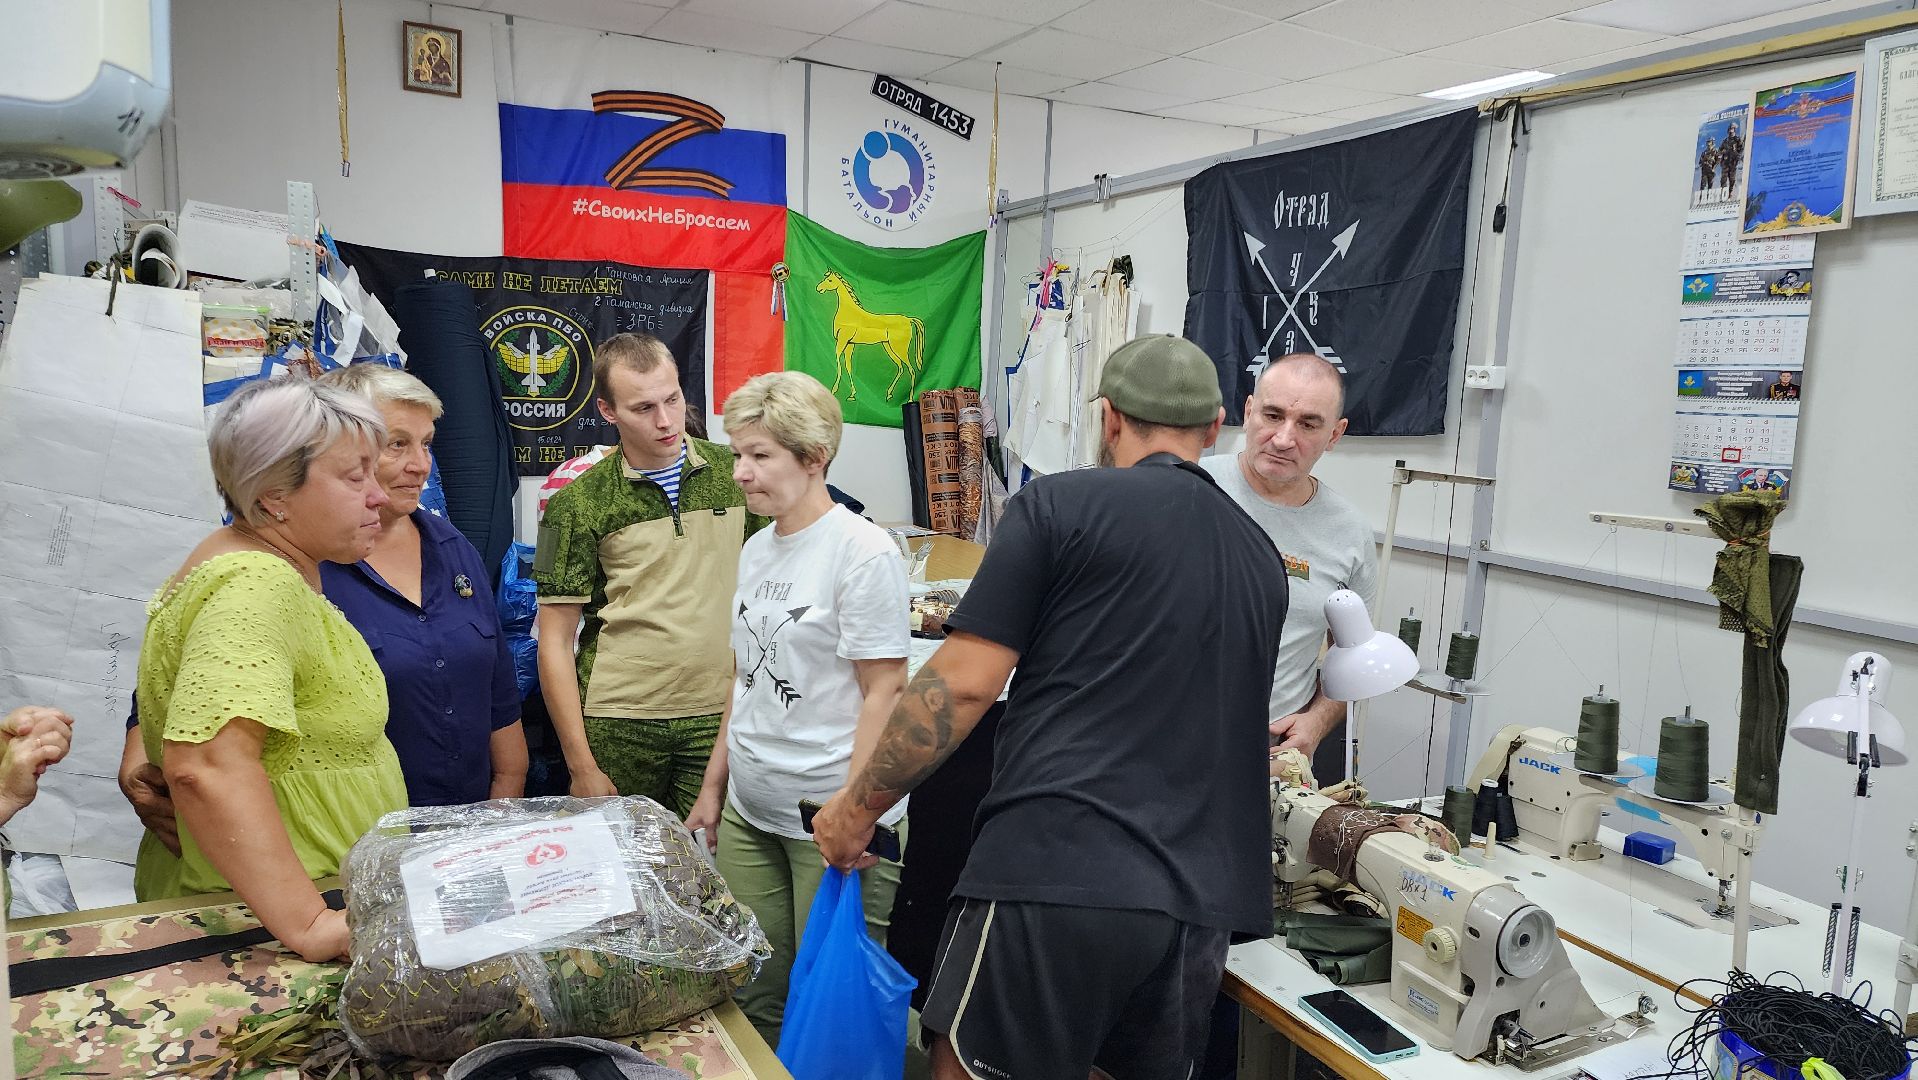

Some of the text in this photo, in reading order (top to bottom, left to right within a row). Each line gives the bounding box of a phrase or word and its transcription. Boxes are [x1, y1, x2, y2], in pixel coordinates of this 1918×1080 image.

[878, 80, 971, 135] ОТРЯД 1453
[884, 119, 936, 223] ГУМАНИТАРНЫЙ
[841, 158, 893, 228] БАТАЛЬОН
[572, 198, 751, 231] #СвоихНеБросаем
[503, 272, 532, 291] НЕ
[541, 276, 622, 295] ЛЕТАЕМ
[606, 266, 653, 284] Танковая
[595, 295, 601, 306] 2
[605, 295, 654, 311] Таманская
[484, 312, 582, 342] ВОЙСКА ПВО
[540, 446, 565, 462] НЕ
[1519, 757, 1561, 775] JACK
